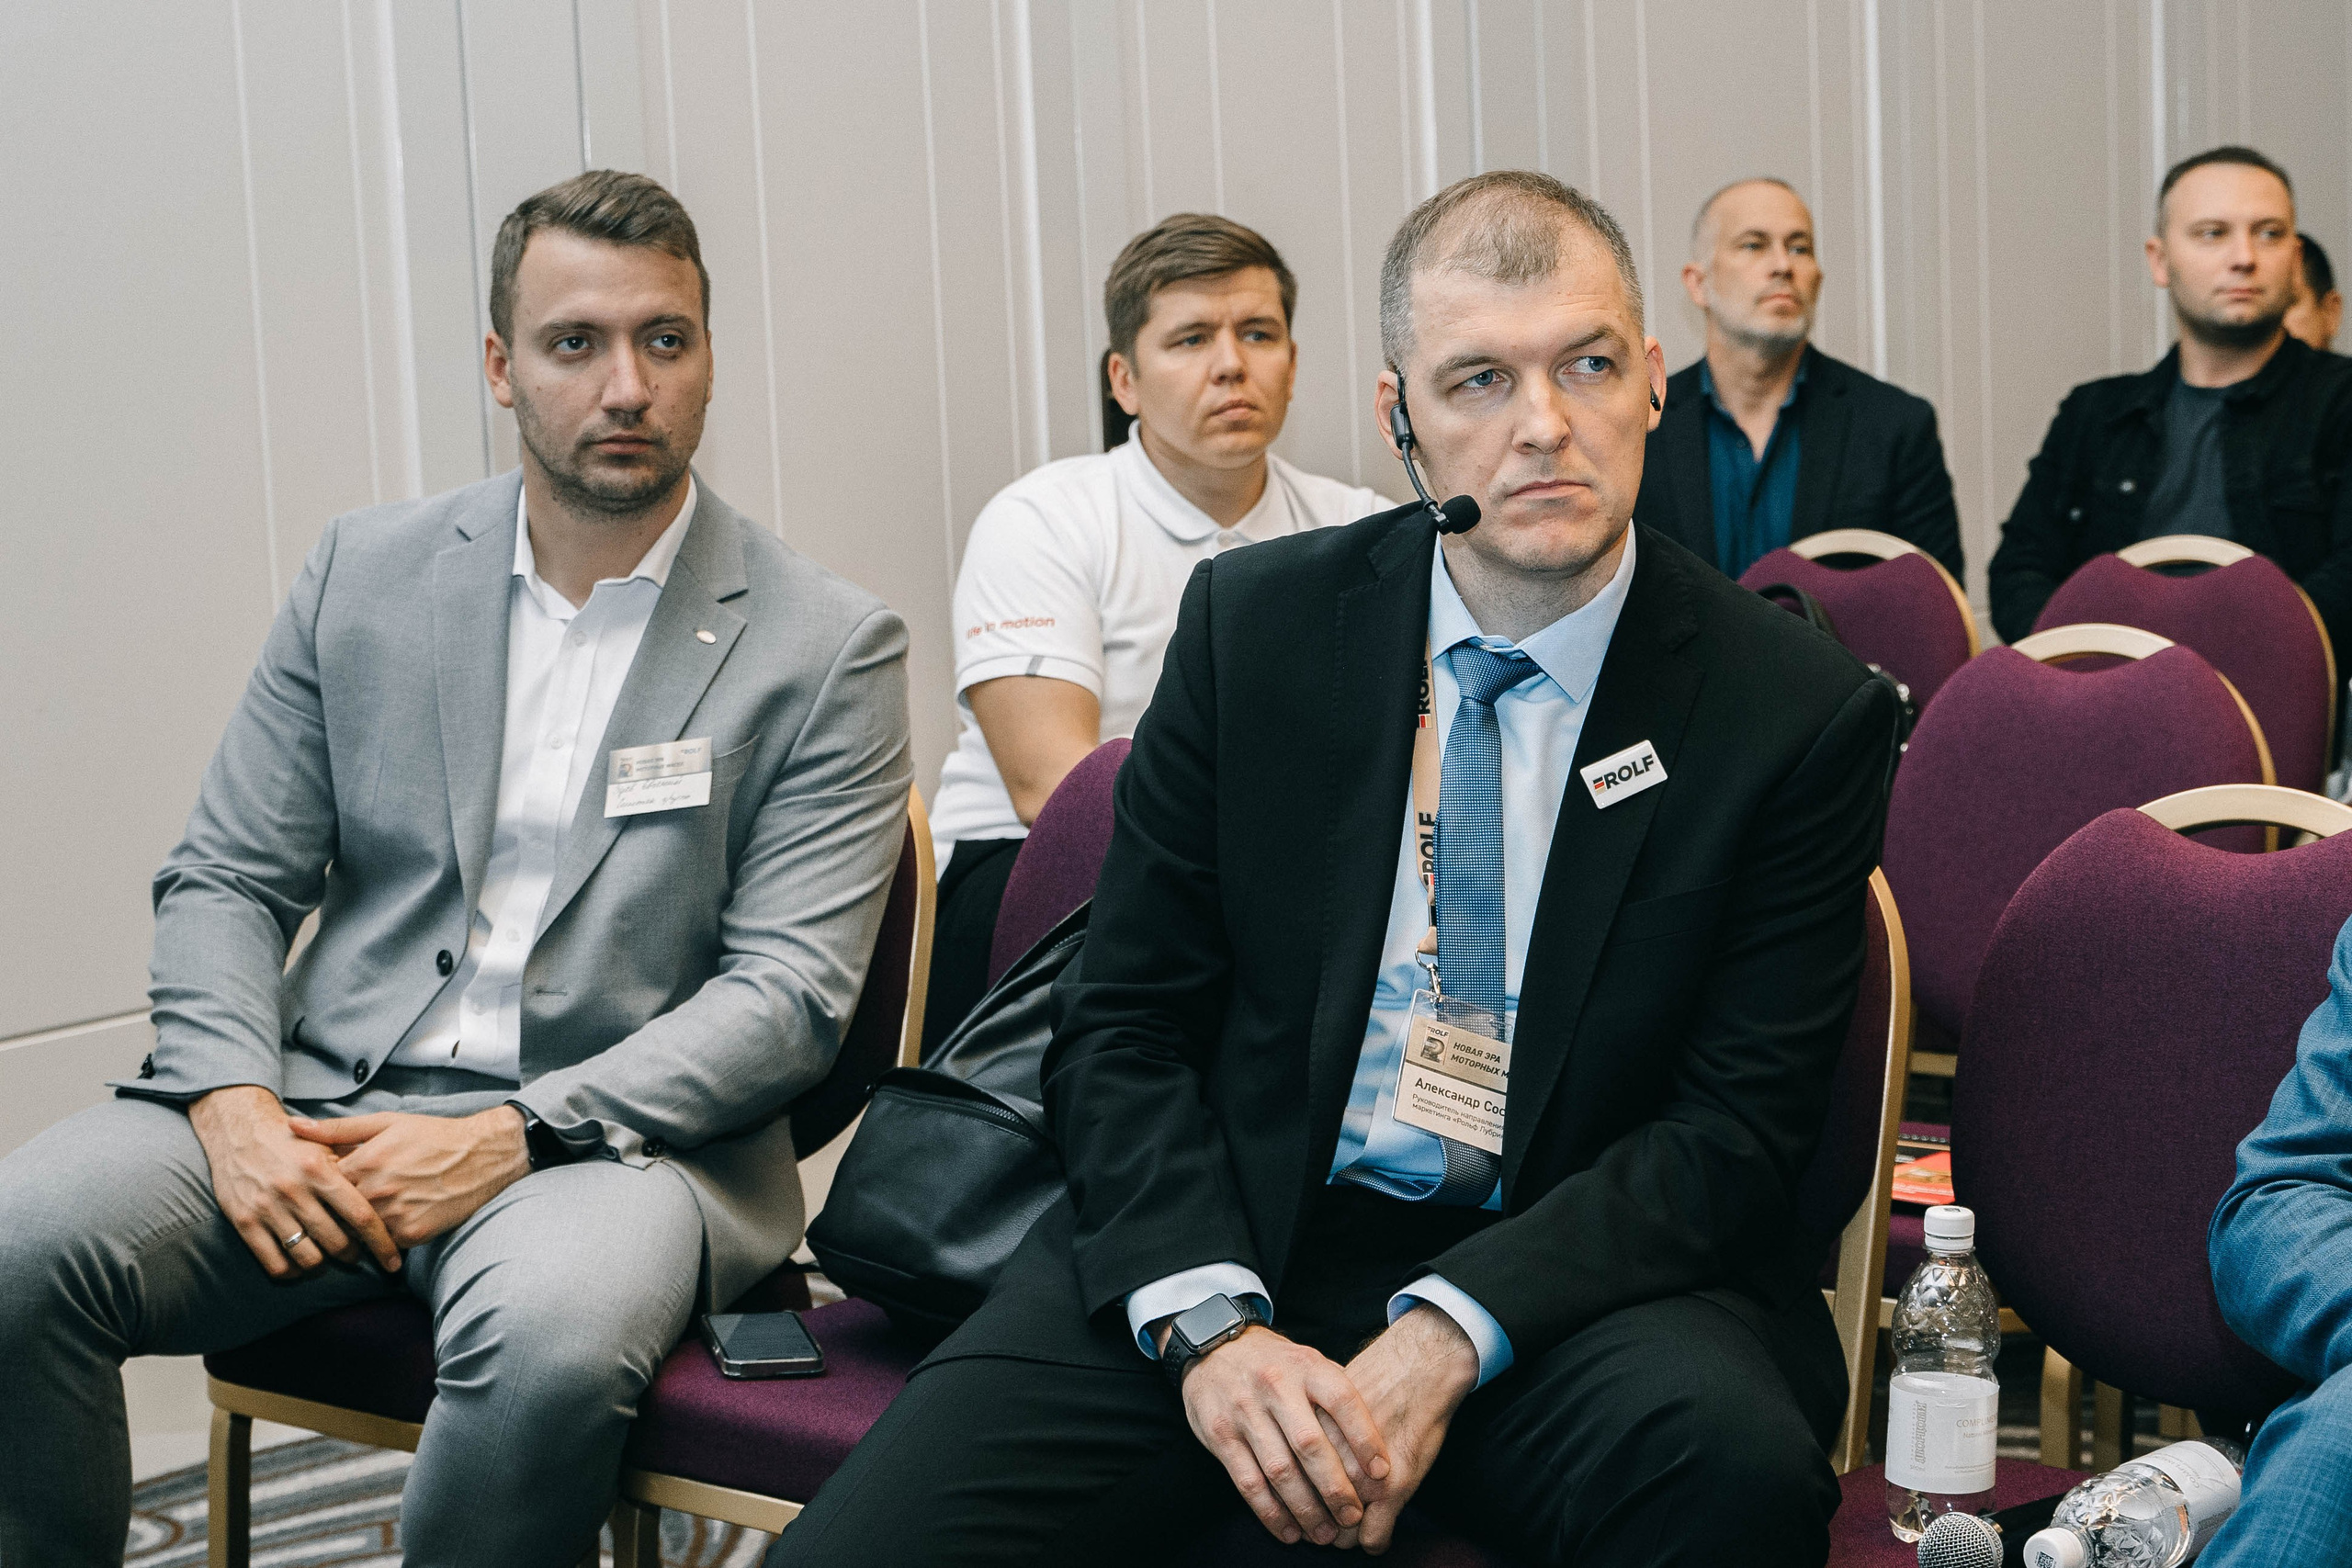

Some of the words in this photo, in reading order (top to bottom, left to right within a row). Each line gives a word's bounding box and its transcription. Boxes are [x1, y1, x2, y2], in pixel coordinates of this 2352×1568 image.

[1001, 616, 1056, 628] motion
[1603, 753, 1654, 790] ROLF
[1430, 1027, 1449, 1037] ROLF
[1453, 1042, 1484, 1057] НОВАЯ
[1484, 1052, 1501, 1064] ЭРА
[1451, 1054, 1501, 1076] МОТОРНЫХ
[1412, 1093, 1459, 1115] Руководитель
[1415, 1077, 1480, 1110] Александр
[1412, 1103, 1452, 1122] маркетинга
[1453, 1118, 1478, 1132] «Рольф
